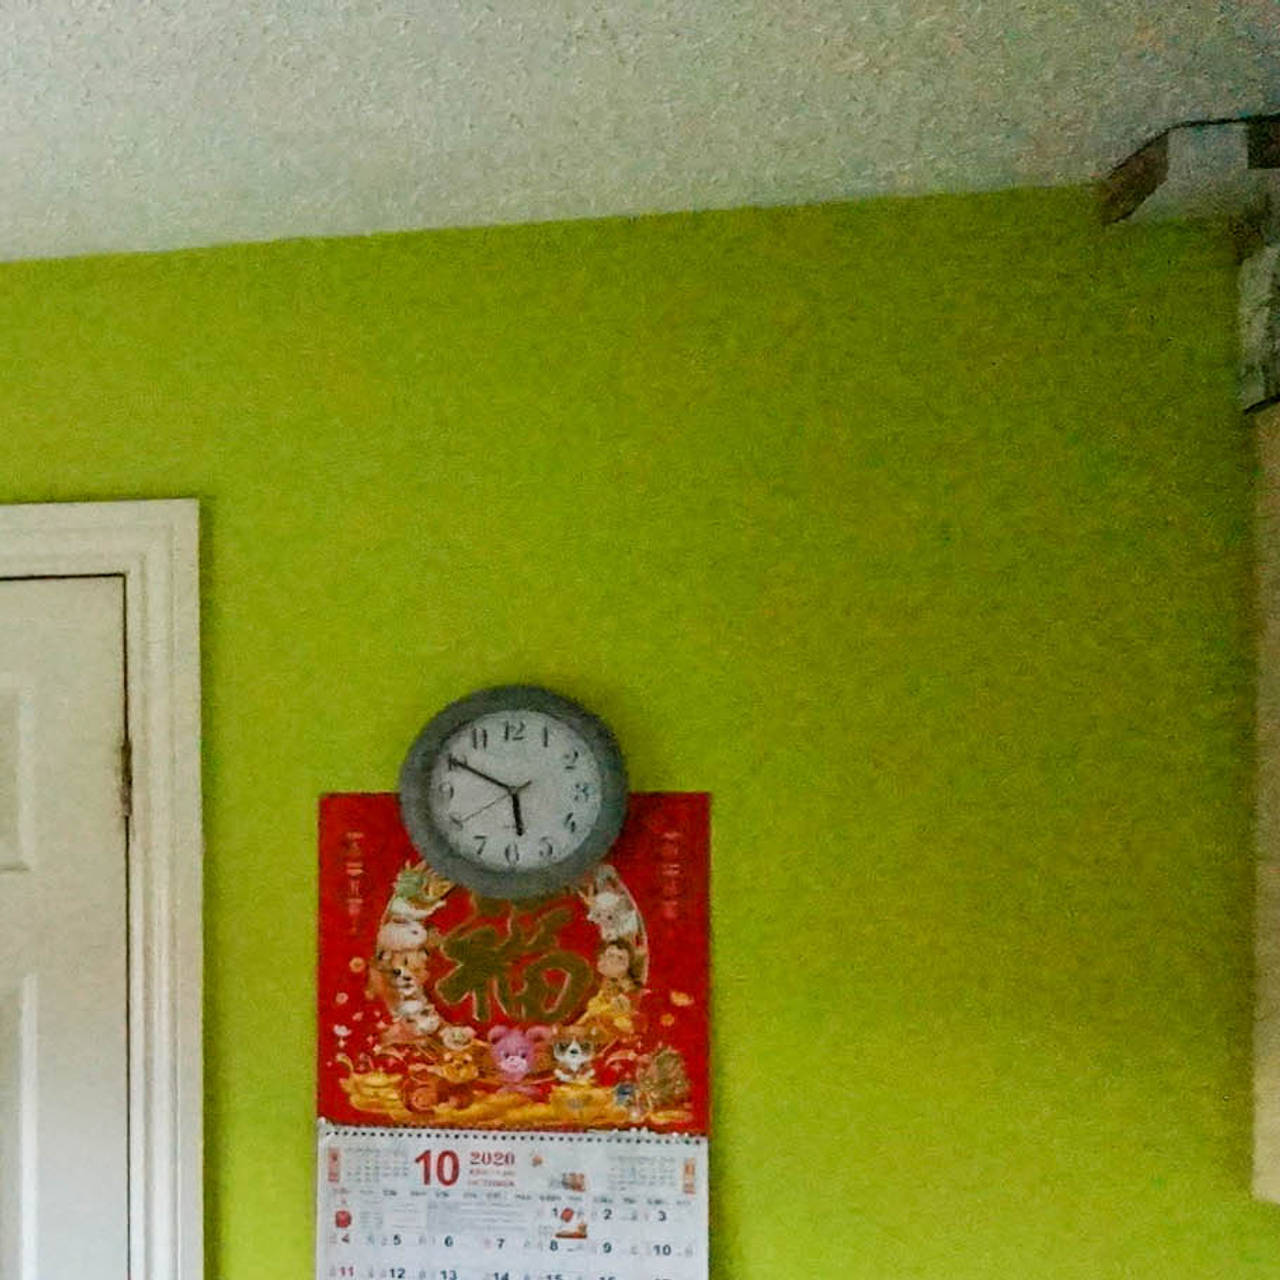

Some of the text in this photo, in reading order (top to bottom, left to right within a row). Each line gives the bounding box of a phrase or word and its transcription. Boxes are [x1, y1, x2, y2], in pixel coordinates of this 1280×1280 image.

[472, 728, 488, 749] 11
[504, 720, 525, 741] 12
[543, 726, 549, 748] 1
[564, 750, 579, 770] 2
[439, 782, 455, 800] 9
[574, 783, 591, 801] 3
[474, 835, 488, 855] 7
[504, 844, 520, 864] 6
[539, 836, 554, 858] 5
[414, 1149, 460, 1187] 10
[470, 1151, 515, 1166] 2020
[552, 1207, 667, 1221] 1 2 3
[341, 1233, 672, 1256] 4 5 6 7 8 9 10
[339, 1266, 354, 1277] 11
[390, 1268, 406, 1279] 12
[441, 1270, 457, 1280] 13
